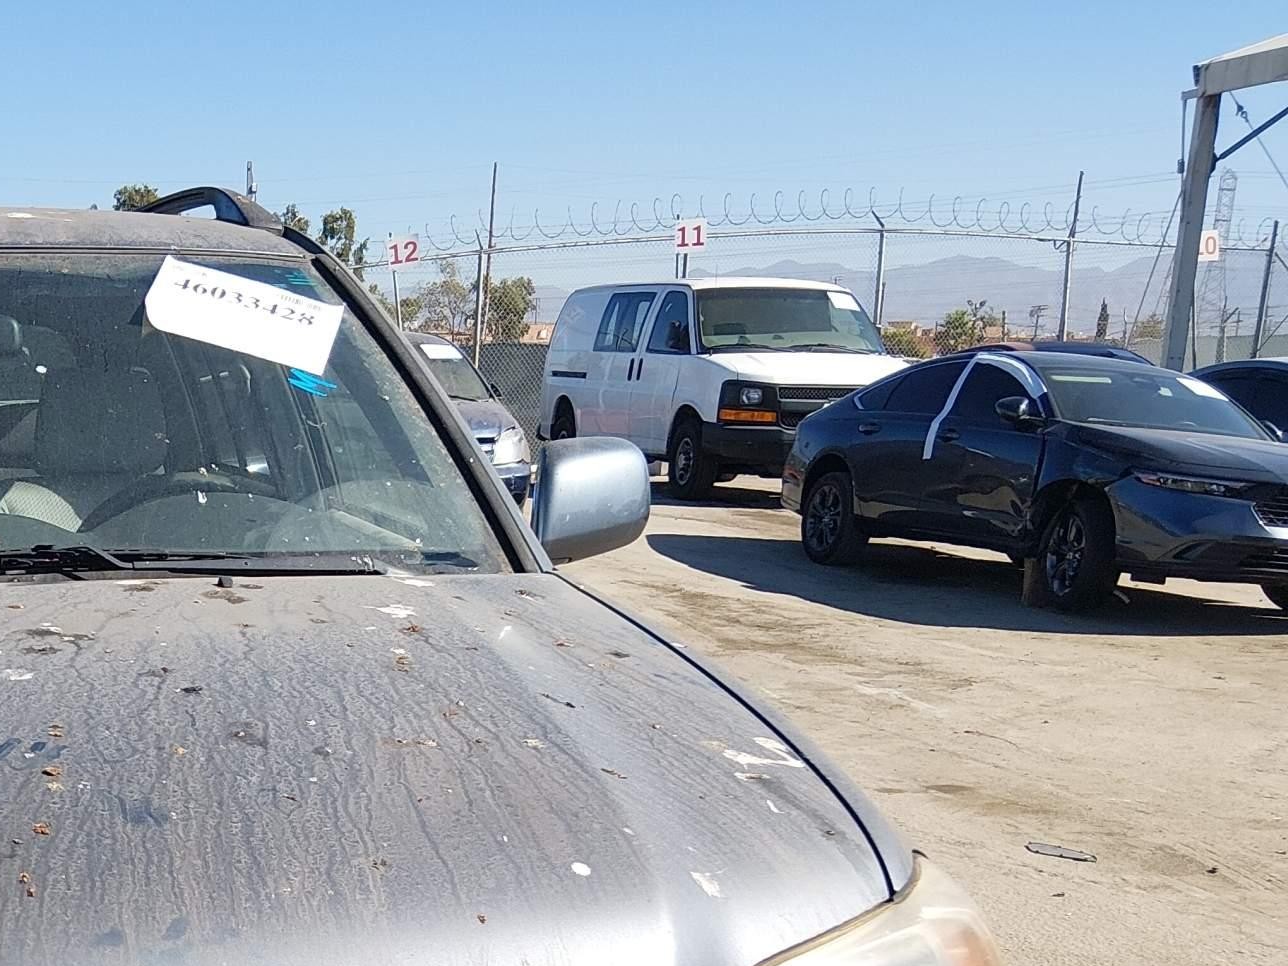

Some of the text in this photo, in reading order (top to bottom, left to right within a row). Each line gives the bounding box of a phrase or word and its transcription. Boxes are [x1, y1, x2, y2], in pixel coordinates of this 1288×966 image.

[677, 225, 704, 247] 11
[1199, 236, 1216, 255] 0
[389, 241, 419, 265] 12
[173, 278, 316, 326] 46033428
